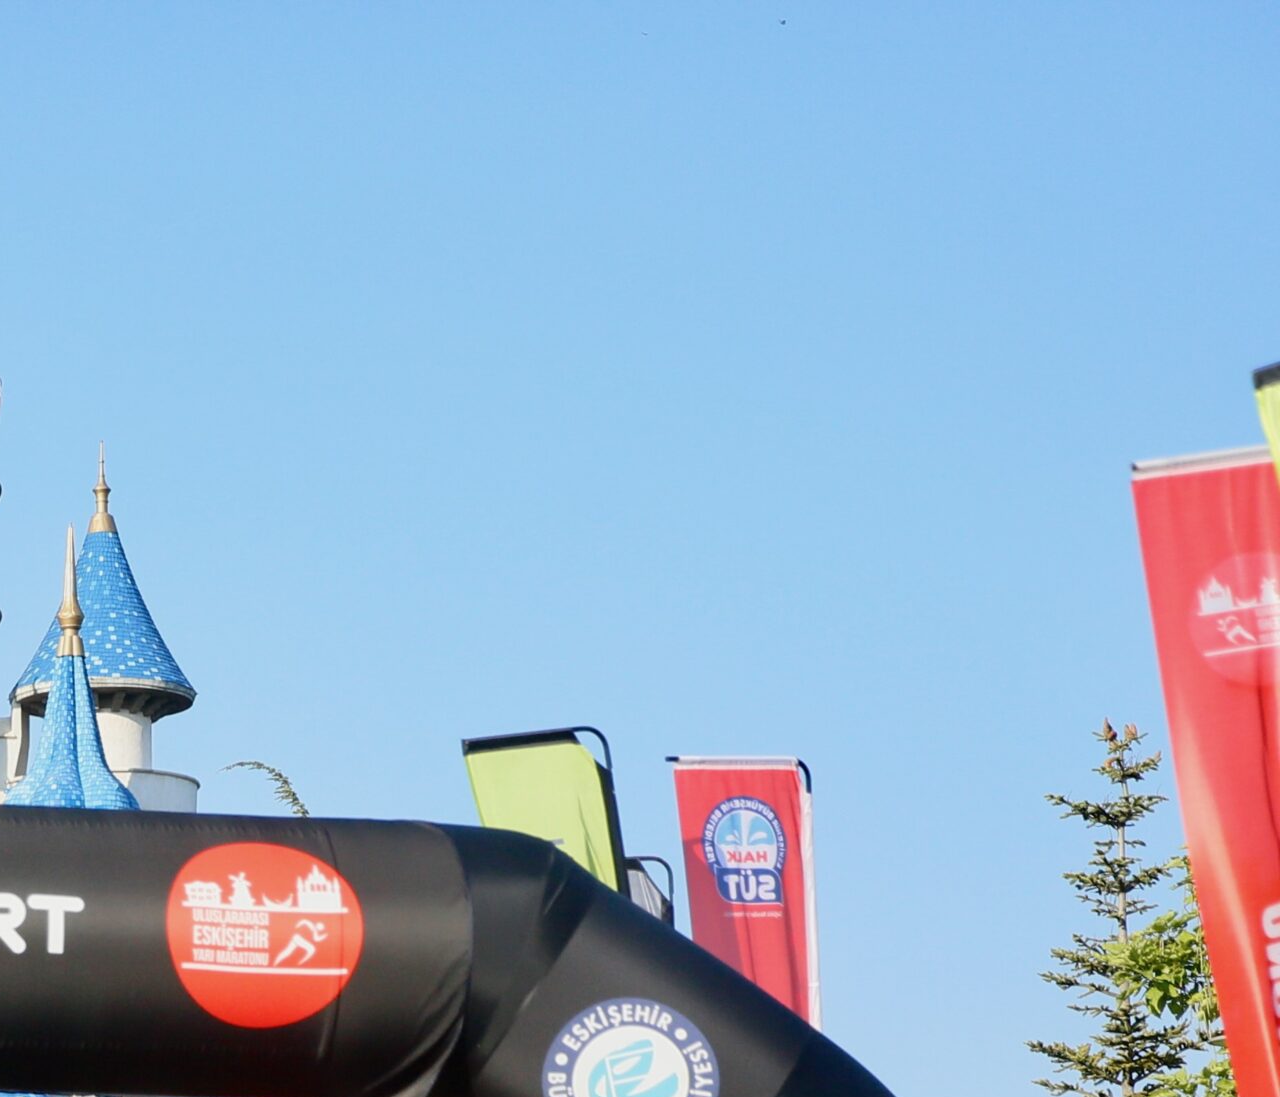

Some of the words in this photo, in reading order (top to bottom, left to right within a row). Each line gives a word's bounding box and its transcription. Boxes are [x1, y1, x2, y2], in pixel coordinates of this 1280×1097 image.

[191, 908, 270, 926] ULUSLARARASI
[192, 924, 270, 950] ESKİŞEHİR
[191, 948, 215, 963] YARI
[216, 949, 270, 967] MARATONU
[561, 1003, 674, 1052] ESKİŞEHİR
